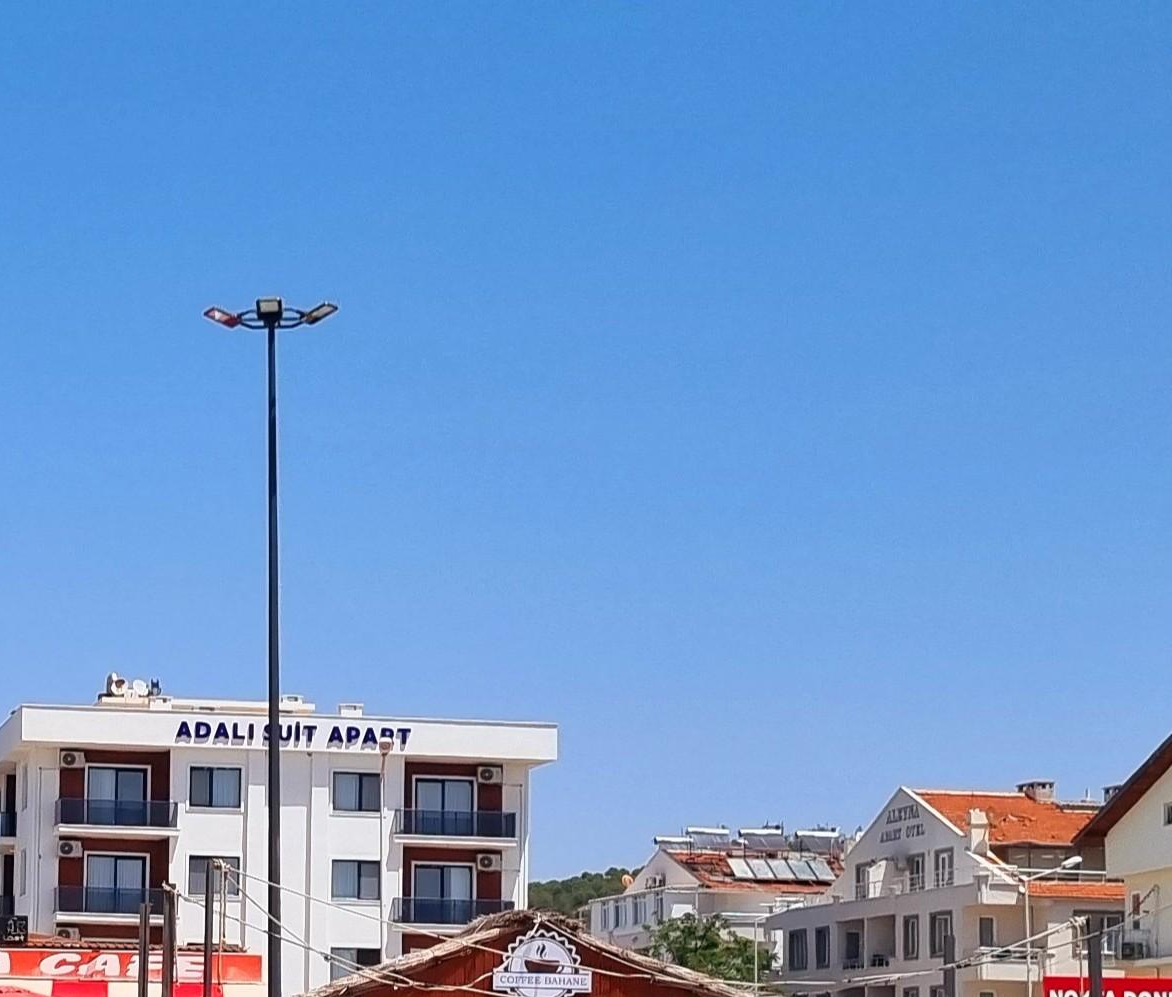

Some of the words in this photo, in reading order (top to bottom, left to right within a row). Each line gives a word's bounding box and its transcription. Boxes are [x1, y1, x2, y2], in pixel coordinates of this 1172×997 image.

[176, 721, 255, 742] ADALI
[328, 725, 412, 746] APART
[39, 952, 205, 981] CAFE
[500, 975, 541, 986] COFFEE
